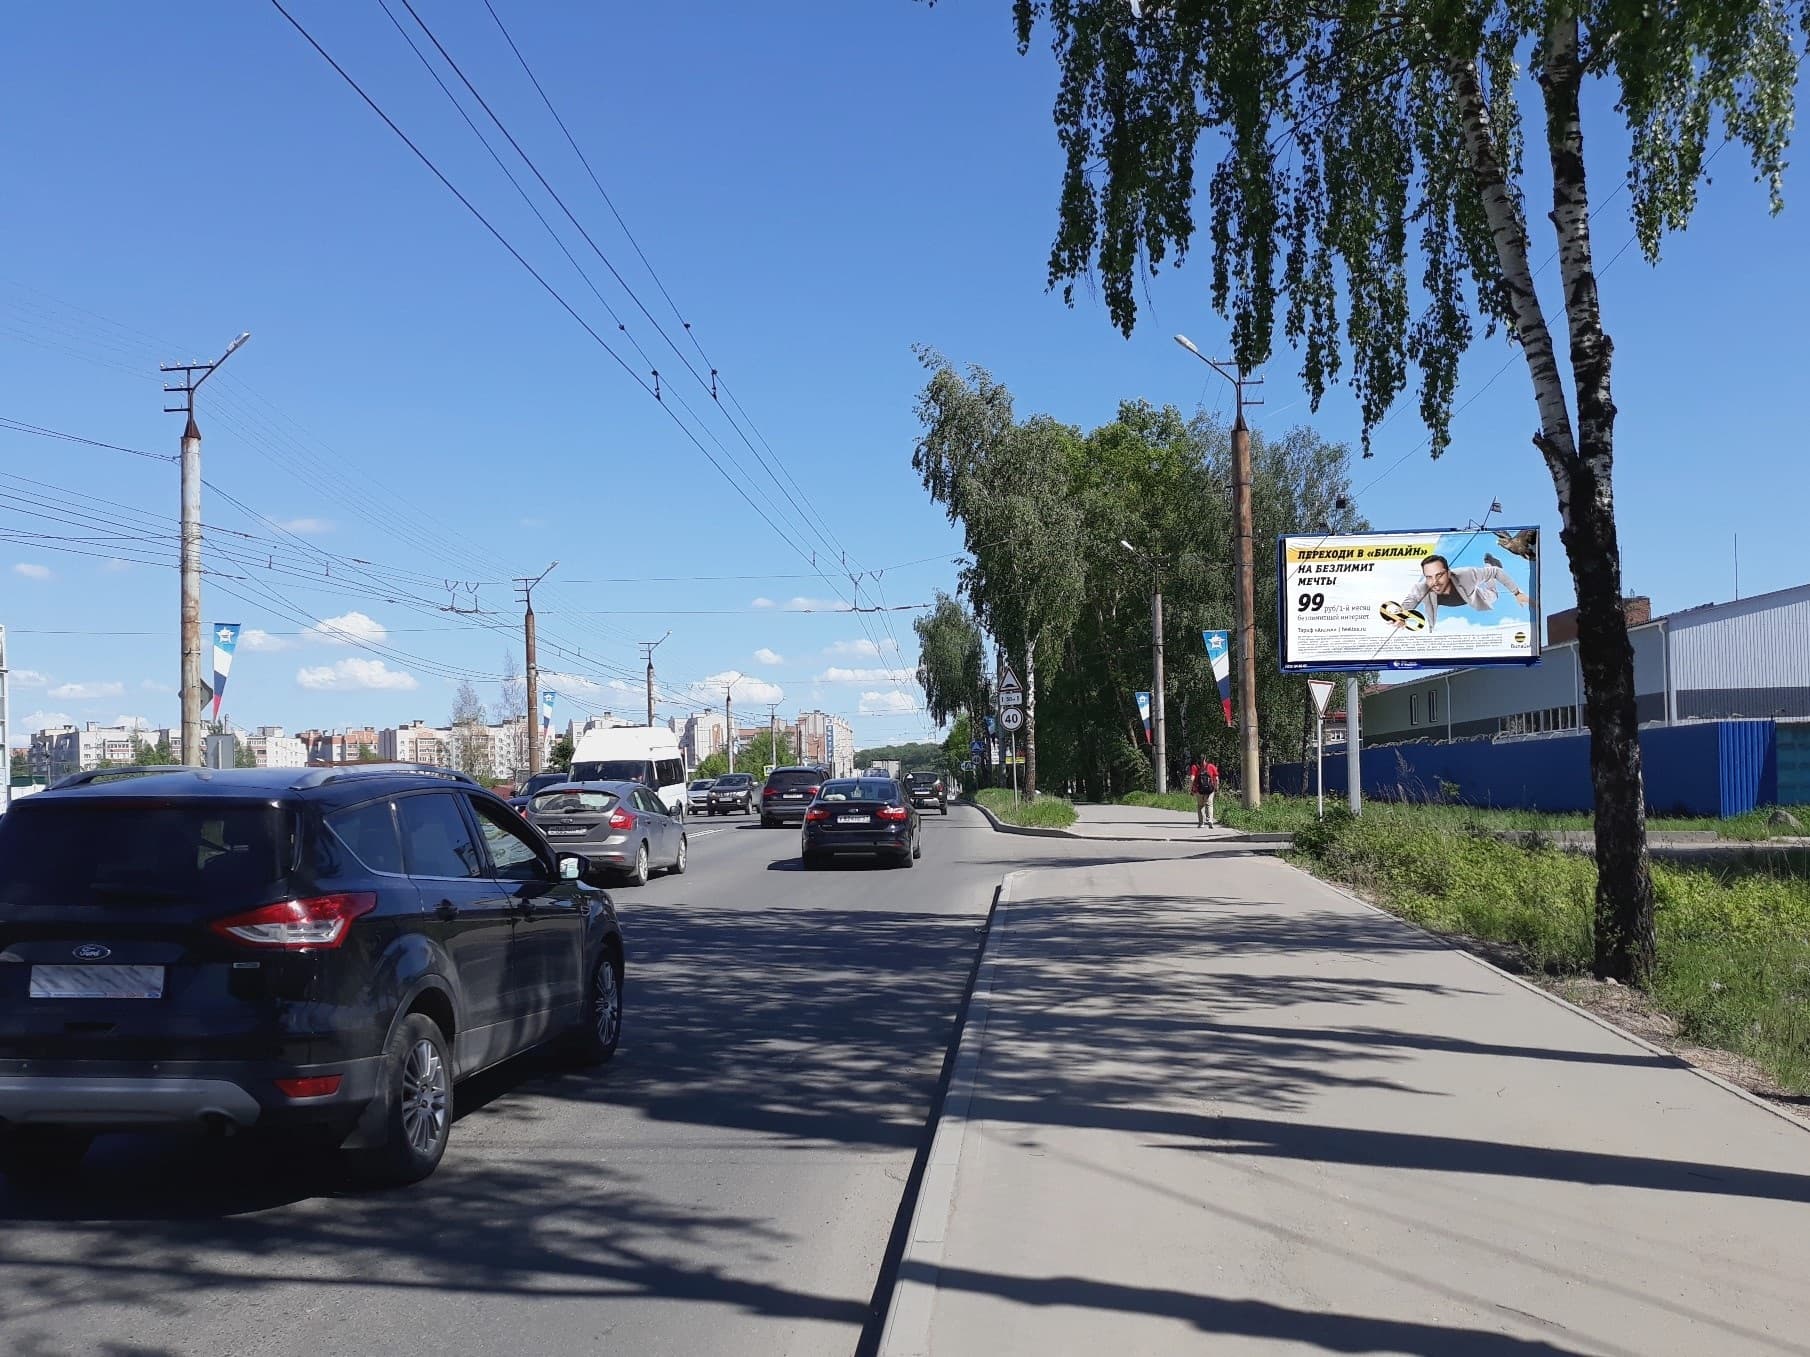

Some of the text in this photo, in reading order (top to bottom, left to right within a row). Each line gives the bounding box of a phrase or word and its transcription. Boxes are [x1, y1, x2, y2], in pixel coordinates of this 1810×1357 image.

[1297, 545, 1428, 560] ПЕРЕХОДИ В «БИЛАЙН»
[1297, 563, 1375, 574] НА БЕЗЛИМИТ
[1297, 577, 1337, 586] МЕЧТЫ
[1297, 593, 1325, 612] 99
[1005, 713, 1018, 724] 40
